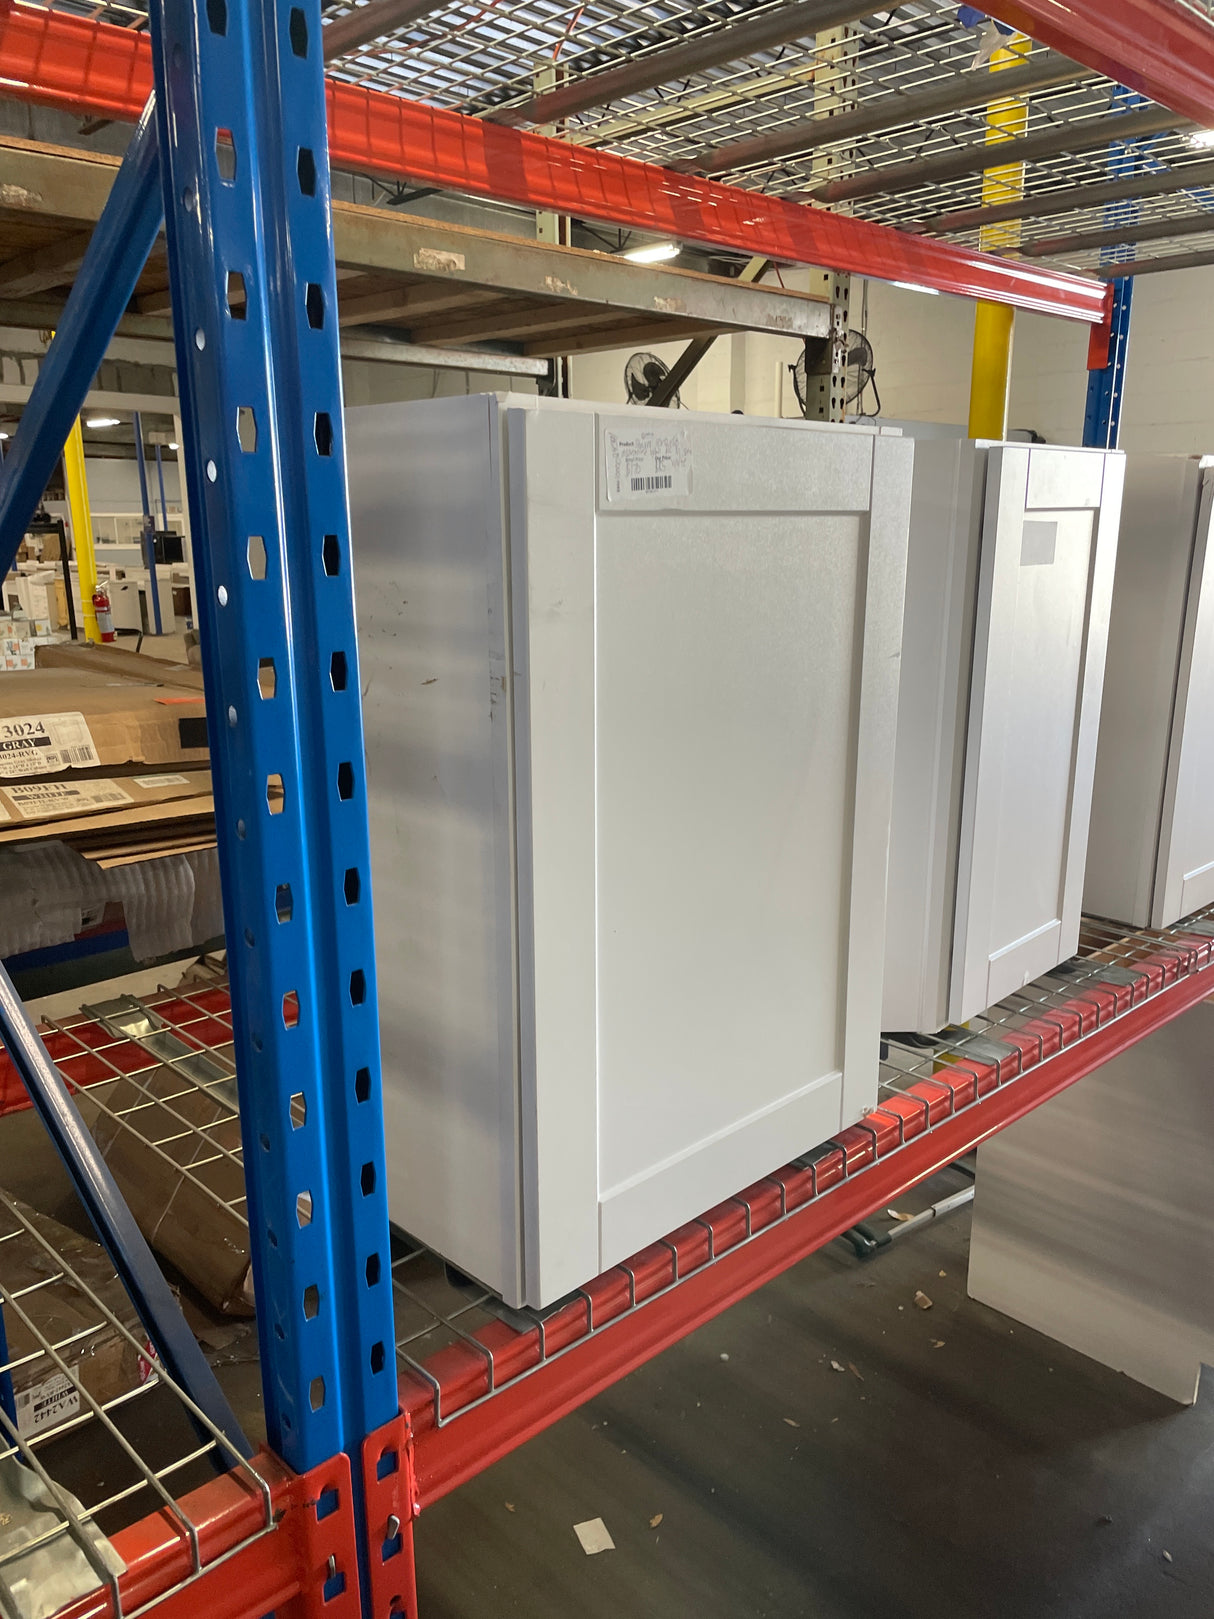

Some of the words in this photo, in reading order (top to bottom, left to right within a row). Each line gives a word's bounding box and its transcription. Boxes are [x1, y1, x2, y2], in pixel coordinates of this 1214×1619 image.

[3, 721, 45, 738] 3024
[2, 739, 36, 750] GRAY
[34, 1396, 78, 1423] WA2442
